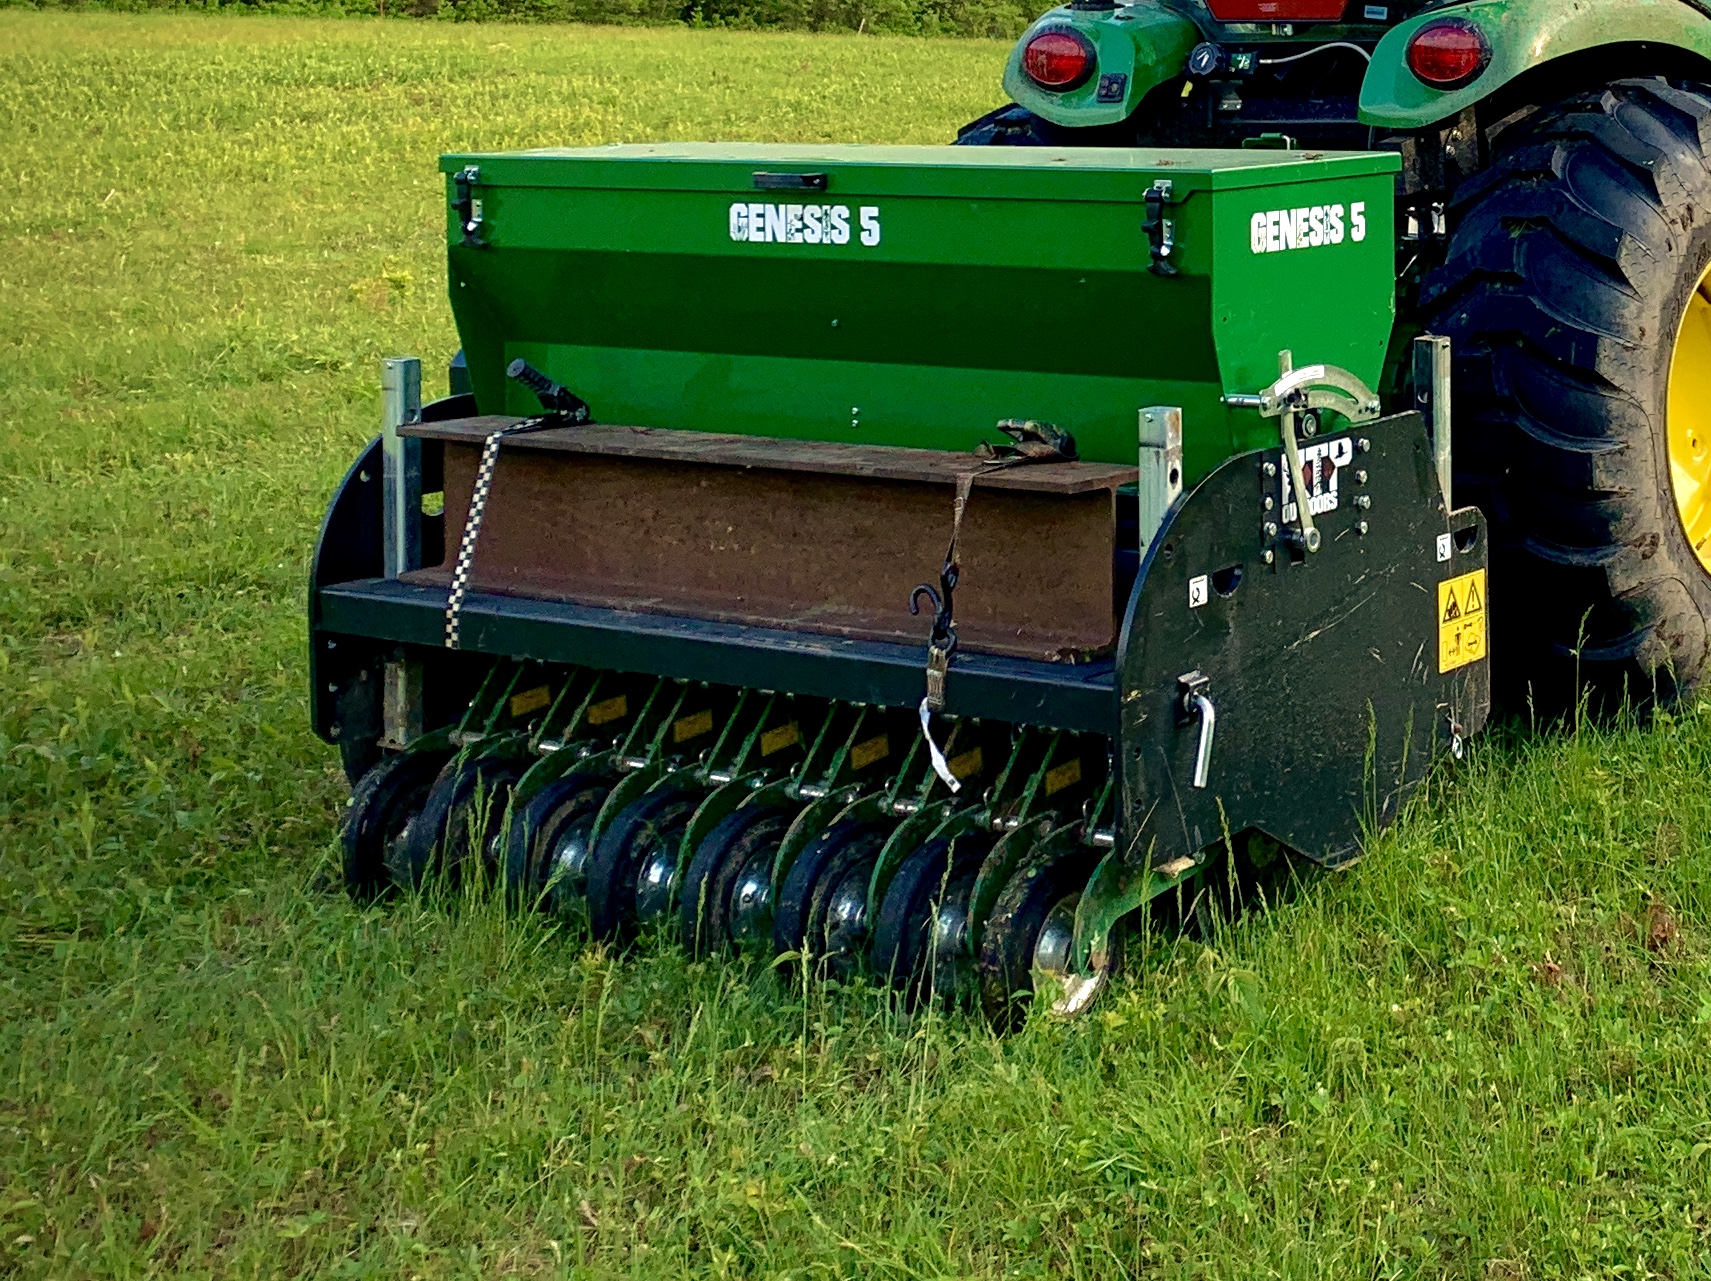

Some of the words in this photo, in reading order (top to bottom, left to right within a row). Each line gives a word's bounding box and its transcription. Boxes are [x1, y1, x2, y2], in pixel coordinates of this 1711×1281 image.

[729, 203, 850, 245] GENESIS
[859, 206, 880, 246] 5
[1250, 204, 1344, 254] GENESIS
[1350, 201, 1366, 242] 5
[1281, 491, 1338, 524] OUOORS
